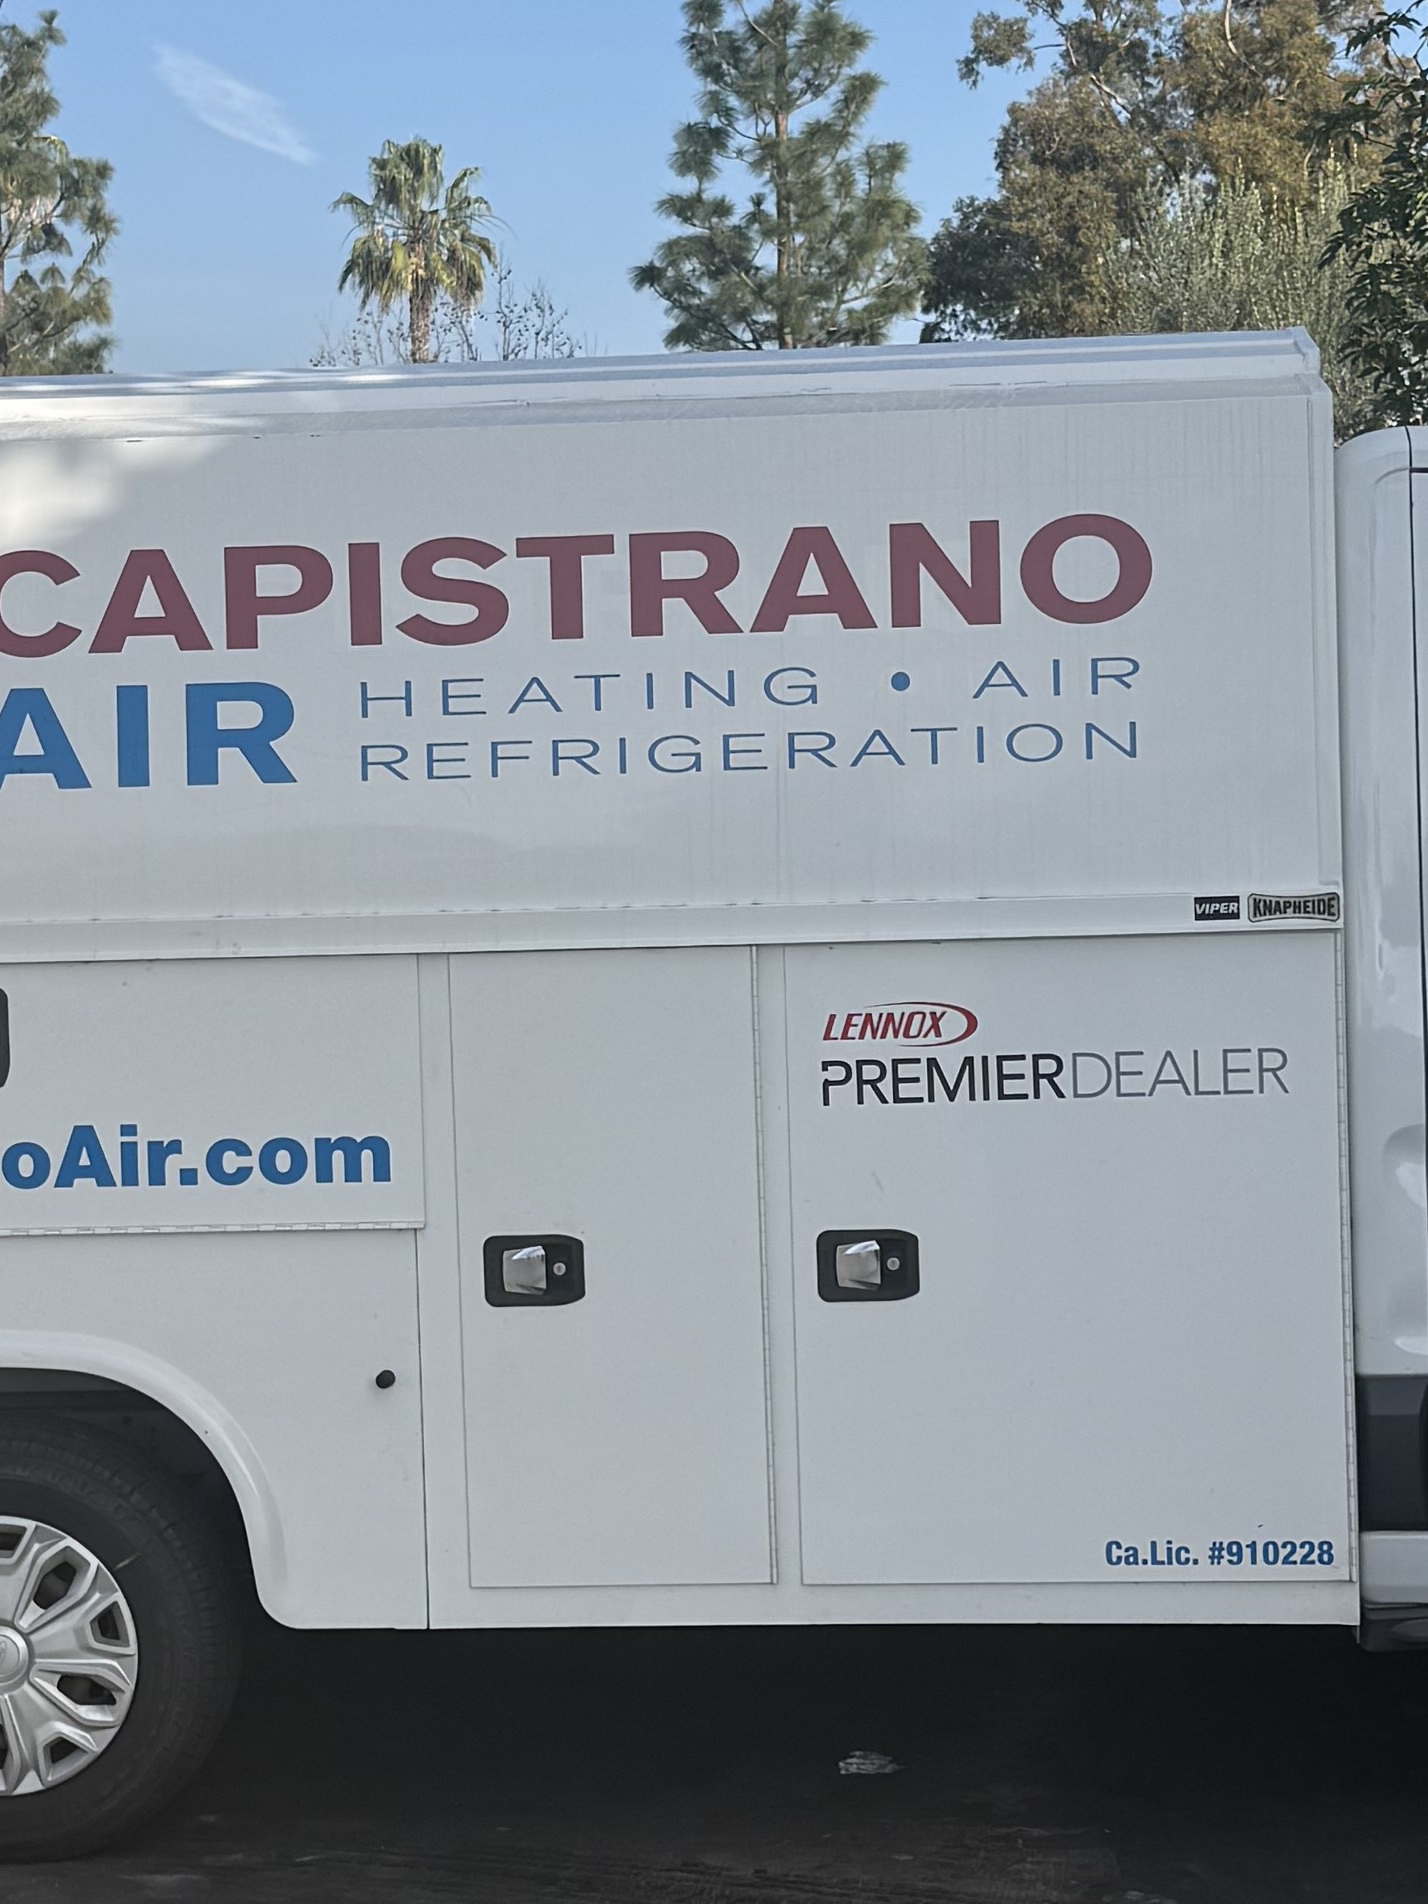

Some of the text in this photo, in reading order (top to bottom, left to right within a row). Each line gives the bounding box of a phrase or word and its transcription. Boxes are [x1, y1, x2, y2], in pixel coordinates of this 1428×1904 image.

[360, 656, 1141, 718] HEATING AIR
[360, 720, 1138, 782] REFRIGERATION
[1195, 902, 1239, 915] VIPER
[1252, 896, 1337, 919] KNAPHEIDE
[822, 1009, 948, 1042] LENNOX
[1105, 1540, 1335, 1566] Ca.Lic. #910228
